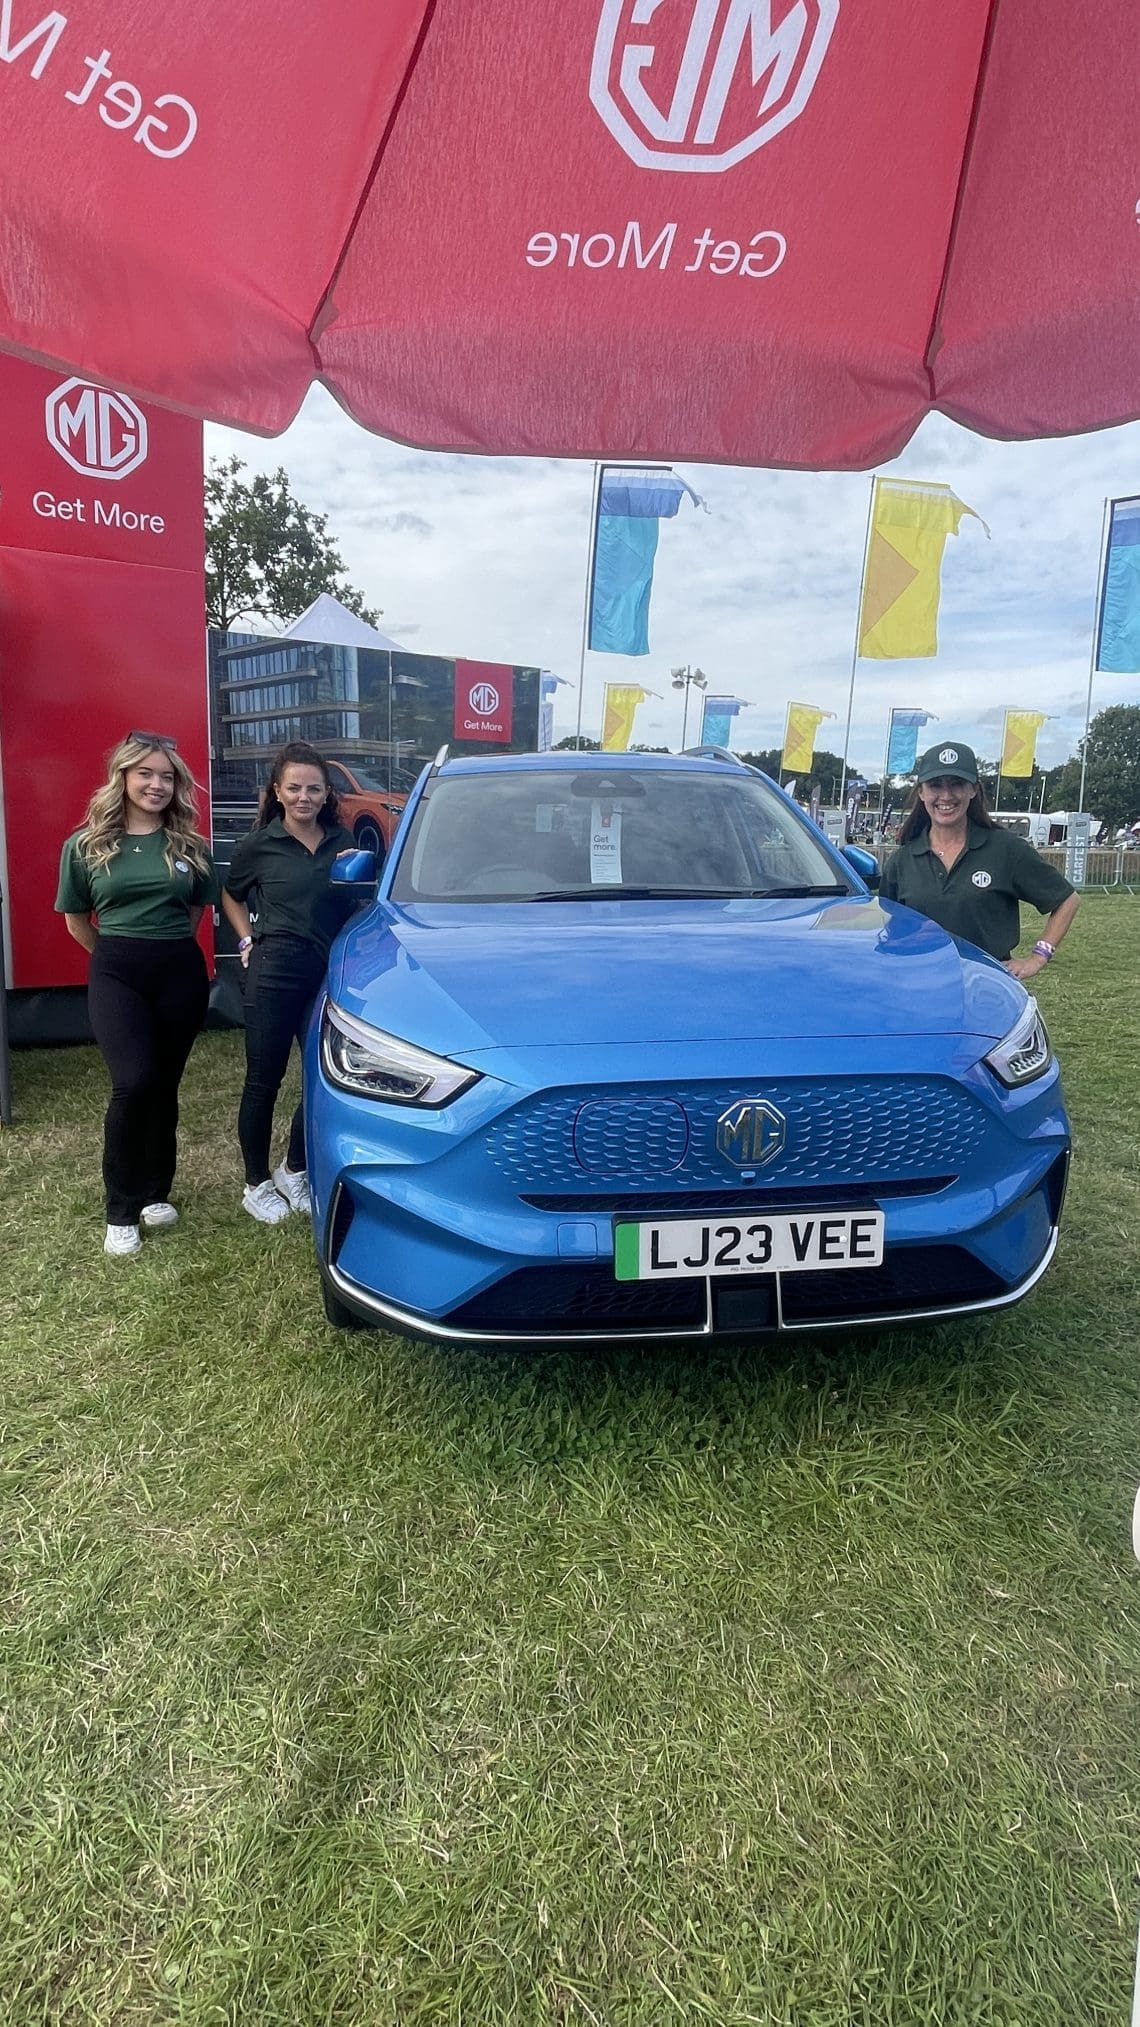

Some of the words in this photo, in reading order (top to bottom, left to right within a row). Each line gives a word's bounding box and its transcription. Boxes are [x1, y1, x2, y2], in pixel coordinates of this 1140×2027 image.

[56, 386, 139, 471] MG
[32, 491, 86, 524] Get
[93, 499, 166, 535] More
[472, 685, 496, 712] MG
[463, 719, 479, 730] Get
[480, 721, 503, 732] More
[940, 750, 957, 763] MG
[846, 797, 855, 819] Jeep
[593, 834, 609, 843] Get
[1072, 834, 1086, 883] CARFEST
[973, 871, 991, 887] MG
[722, 1105, 782, 1161] MG
[650, 1223, 774, 1271] LJ23
[789, 1218, 878, 1262] VEE
